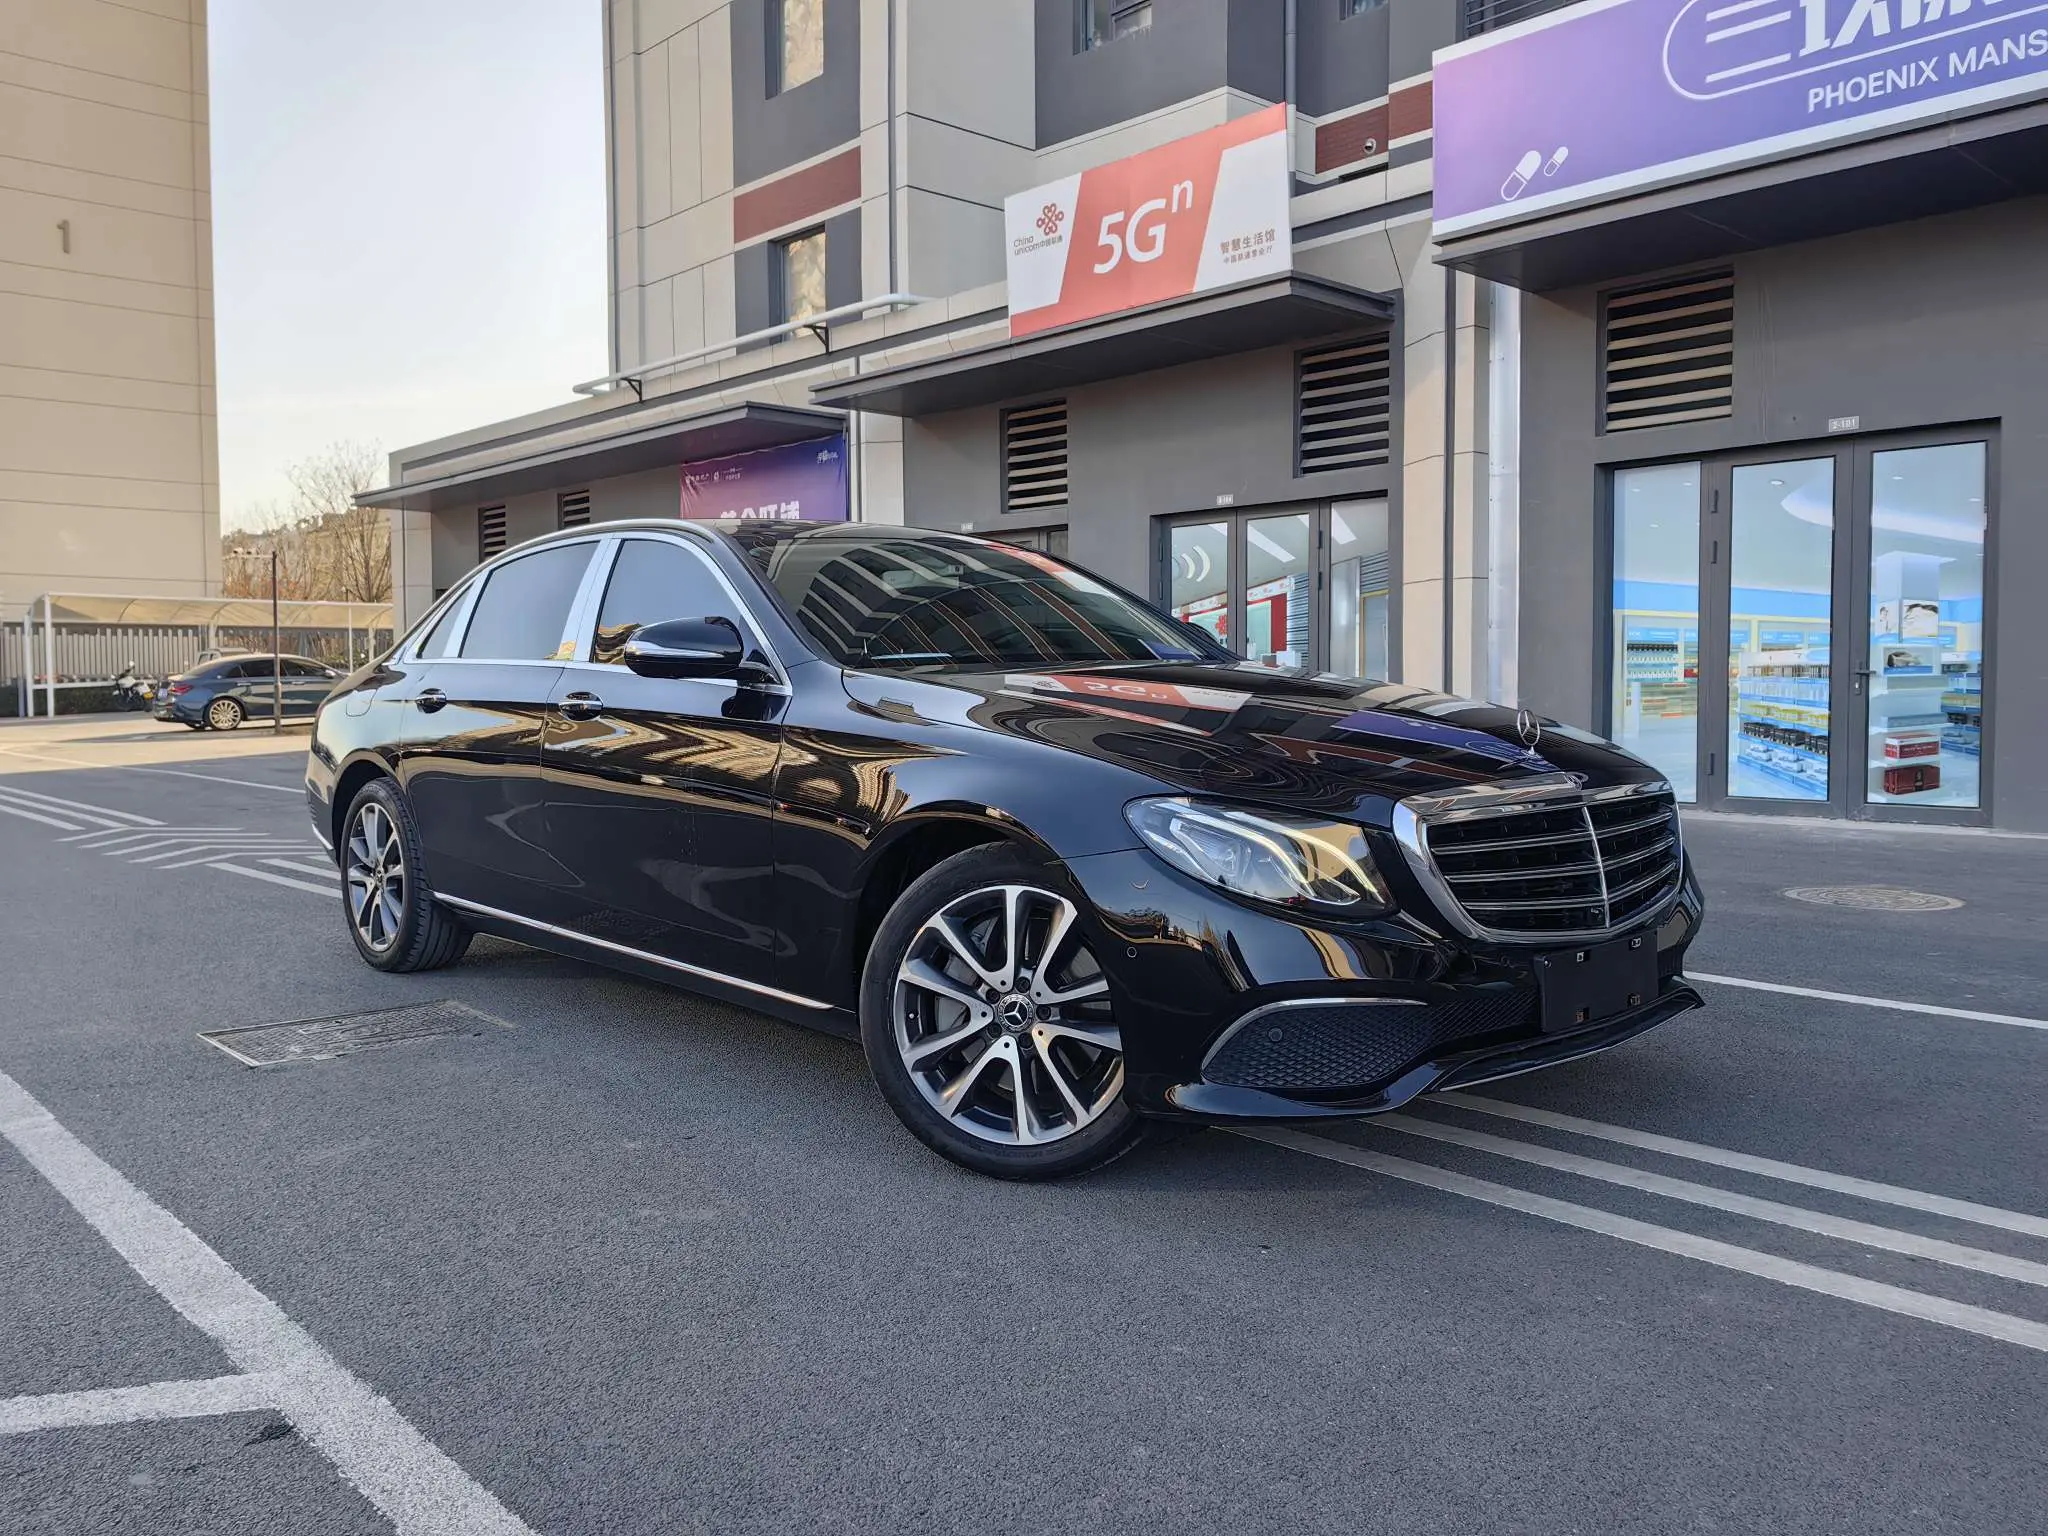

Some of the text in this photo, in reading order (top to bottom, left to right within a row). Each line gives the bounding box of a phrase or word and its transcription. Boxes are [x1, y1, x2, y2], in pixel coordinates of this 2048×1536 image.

[1808, 56, 1938, 113] PHOENIX
[56, 219, 71, 255] 1
[1013, 235, 1034, 248] China
[1219, 228, 1276, 254] 智慧生活馆
